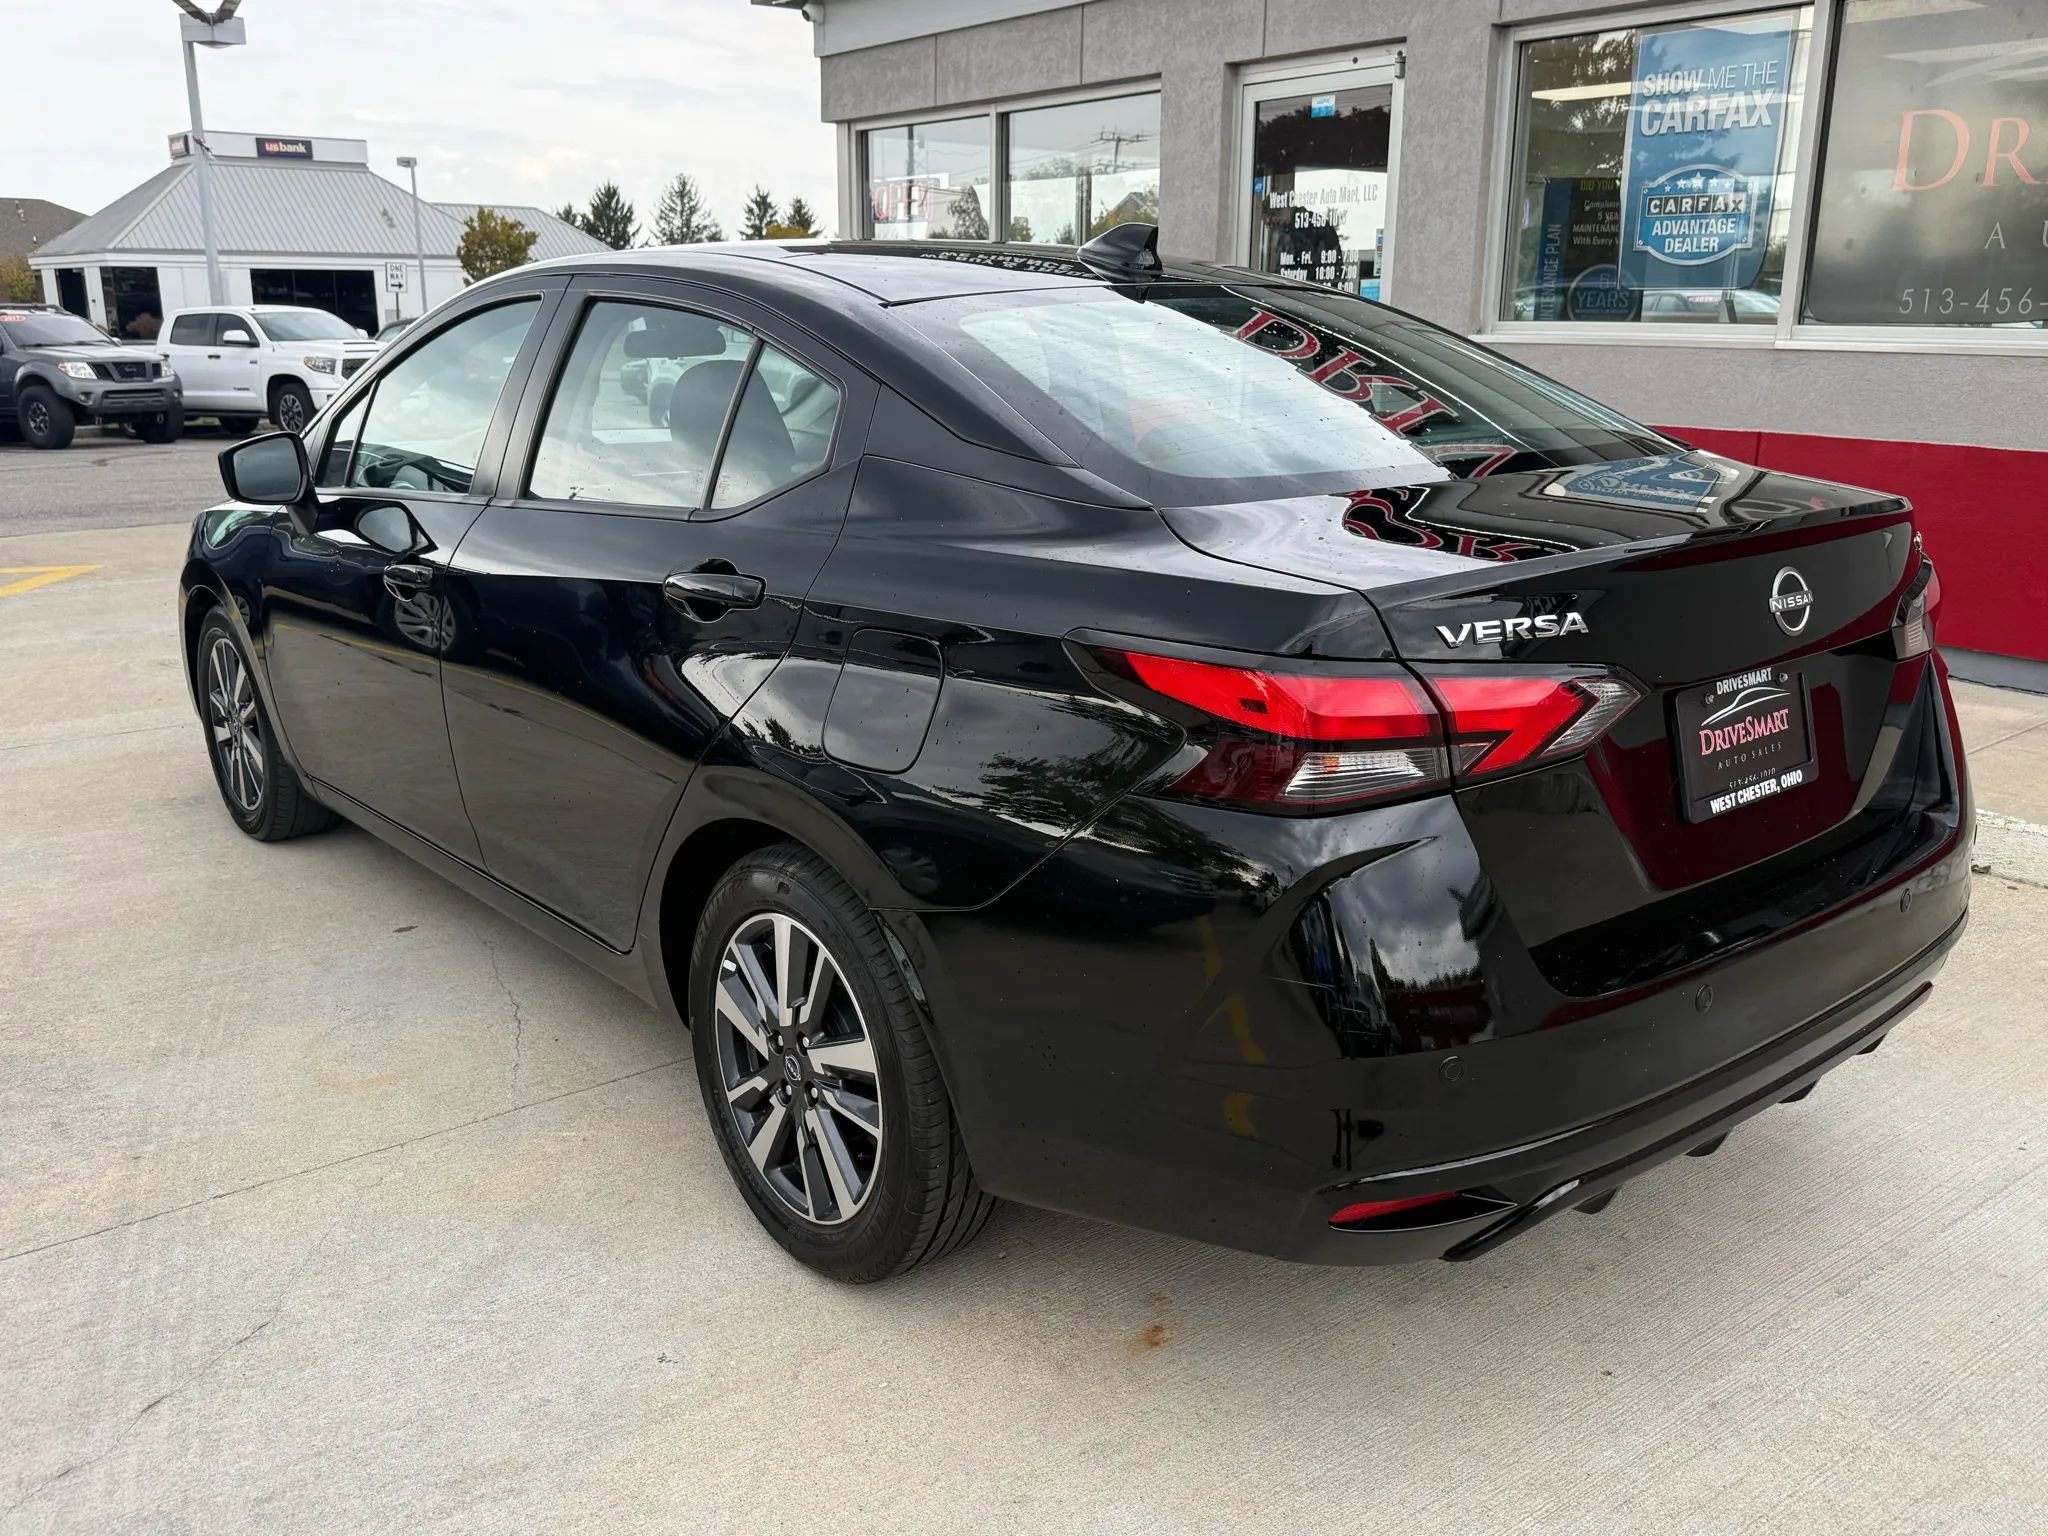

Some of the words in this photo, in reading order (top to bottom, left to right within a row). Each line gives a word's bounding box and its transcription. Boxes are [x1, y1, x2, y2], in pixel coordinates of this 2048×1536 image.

[1643, 69, 1704, 97] SHOW
[1708, 65, 1738, 89] ME
[1742, 61, 1779, 87] THE
[1641, 89, 1774, 137] CARFAX
[1270, 190, 1287, 209] West
[1320, 187, 1337, 205] Auto
[1339, 186, 1360, 205] Mart,
[1363, 183, 1378, 201] LLC
[1650, 197, 1743, 213] CARFAX
[1652, 218, 1736, 236] ADVANTAGE
[1545, 223, 1562, 254] PLAN
[1573, 236, 1590, 245] With
[1592, 236, 1613, 246] Every
[1664, 237, 1720, 253] DEALER
[1280, 252, 1295, 265] Mon.
[1321, 250, 1337, 264] 9:00
[1343, 249, 1359, 262] 7:00
[1315, 265, 1335, 280] 10:00
[1341, 265, 1357, 279] 7:00
[1600, 273, 1610, 289] 5
[1577, 290, 1629, 308] YEARS
[1771, 592, 1814, 611] NISSAN
[1435, 612, 1590, 649] VERSA
[1716, 667, 1772, 695] DRIVESMART
[1699, 708, 1789, 756] DRIVESMART
[1718, 753, 1747, 770] AUTO
[1752, 741, 1782, 759] SALES
[1710, 793, 1736, 814] WEST
[1737, 778, 1781, 804] CHESTER,
[1781, 769, 1803, 788] OHIO
